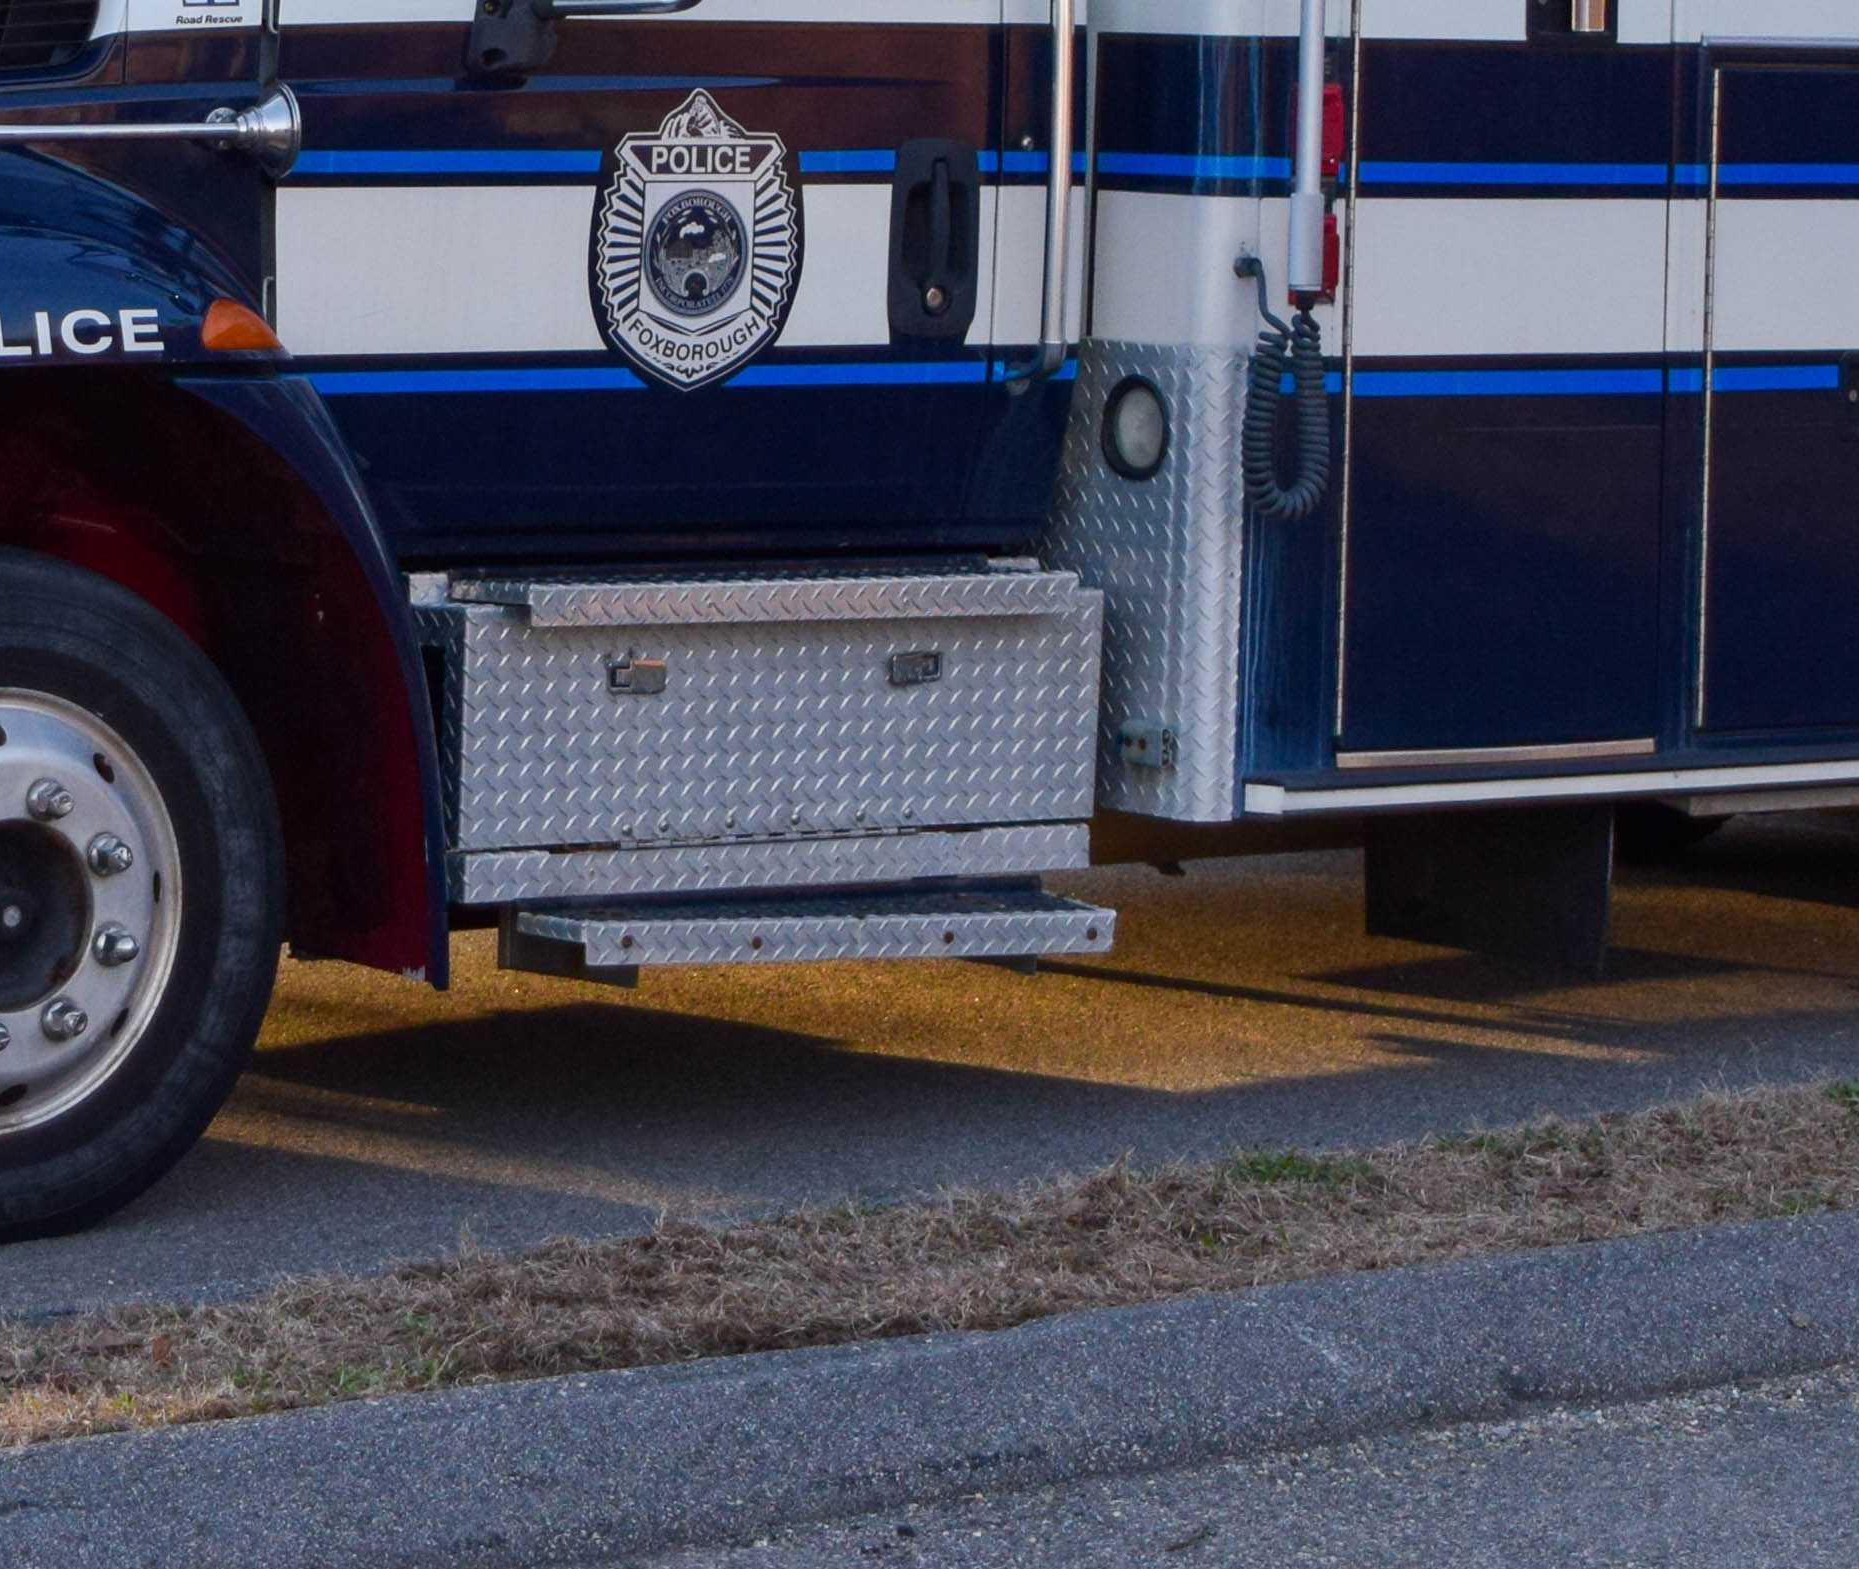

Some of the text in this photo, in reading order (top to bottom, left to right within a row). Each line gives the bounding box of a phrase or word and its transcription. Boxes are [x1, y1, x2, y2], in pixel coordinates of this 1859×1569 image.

[176, 14, 243, 25] Road Rescue
[651, 145, 752, 173] POLICE
[628, 315, 761, 361] FOXBOROUGH
